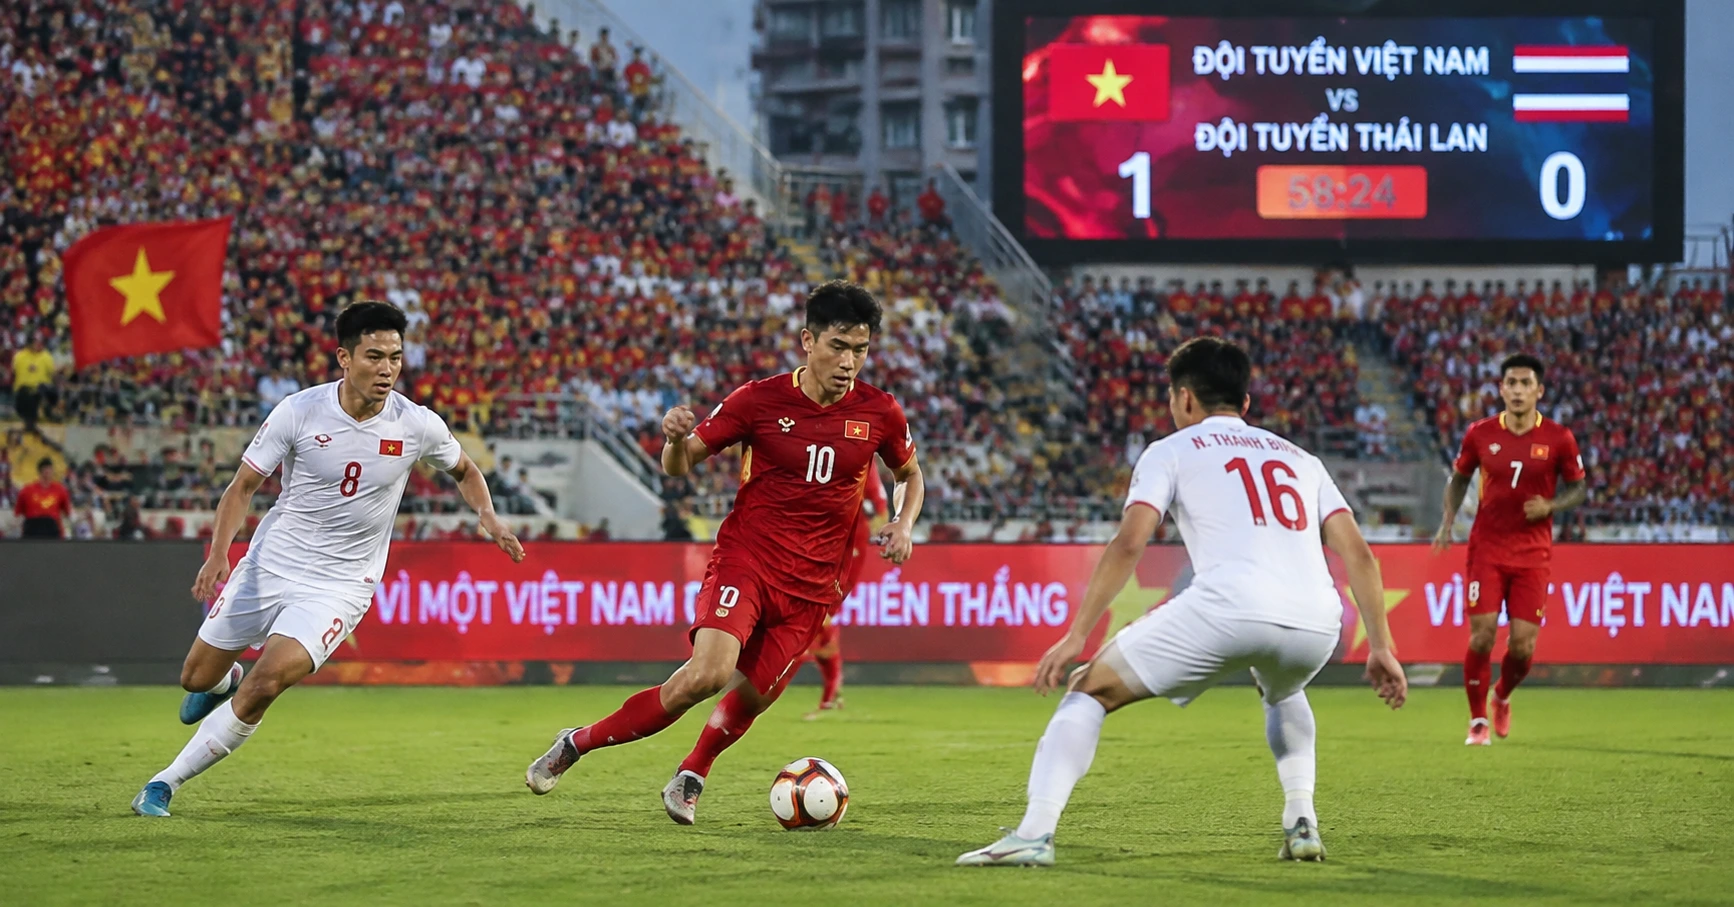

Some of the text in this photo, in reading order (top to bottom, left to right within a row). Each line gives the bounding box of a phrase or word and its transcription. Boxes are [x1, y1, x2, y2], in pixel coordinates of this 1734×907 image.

[1192, 36, 1489, 81] ĐỘI TUYỂN VIỆT NAM
[1325, 88, 1359, 112] VS
[1194, 117, 1247, 157] ĐỘI
[1252, 112, 1349, 152] TUYỂN
[1430, 123, 1487, 152] LAN
[1118, 151, 1152, 219] 1
[1289, 173, 1397, 209] 58:24
[1539, 151, 1587, 220] 0
[806, 444, 835, 484] 10
[1191, 436, 1211, 450] N.
[1209, 434, 1265, 450] THANH
[340, 461, 362, 497] 8
[1224, 457, 1308, 532] 16
[1510, 461, 1523, 489] 7
[375, 569, 411, 624] VÌ
[418, 570, 498, 634] MỘT
[504, 570, 584, 635] VIỆT
[591, 581, 675, 625] NAM
[830, 564, 1068, 627] HIẾN THẮNG
[1424, 572, 1463, 627] VÌ
[1562, 571, 1652, 637] VIỆT
